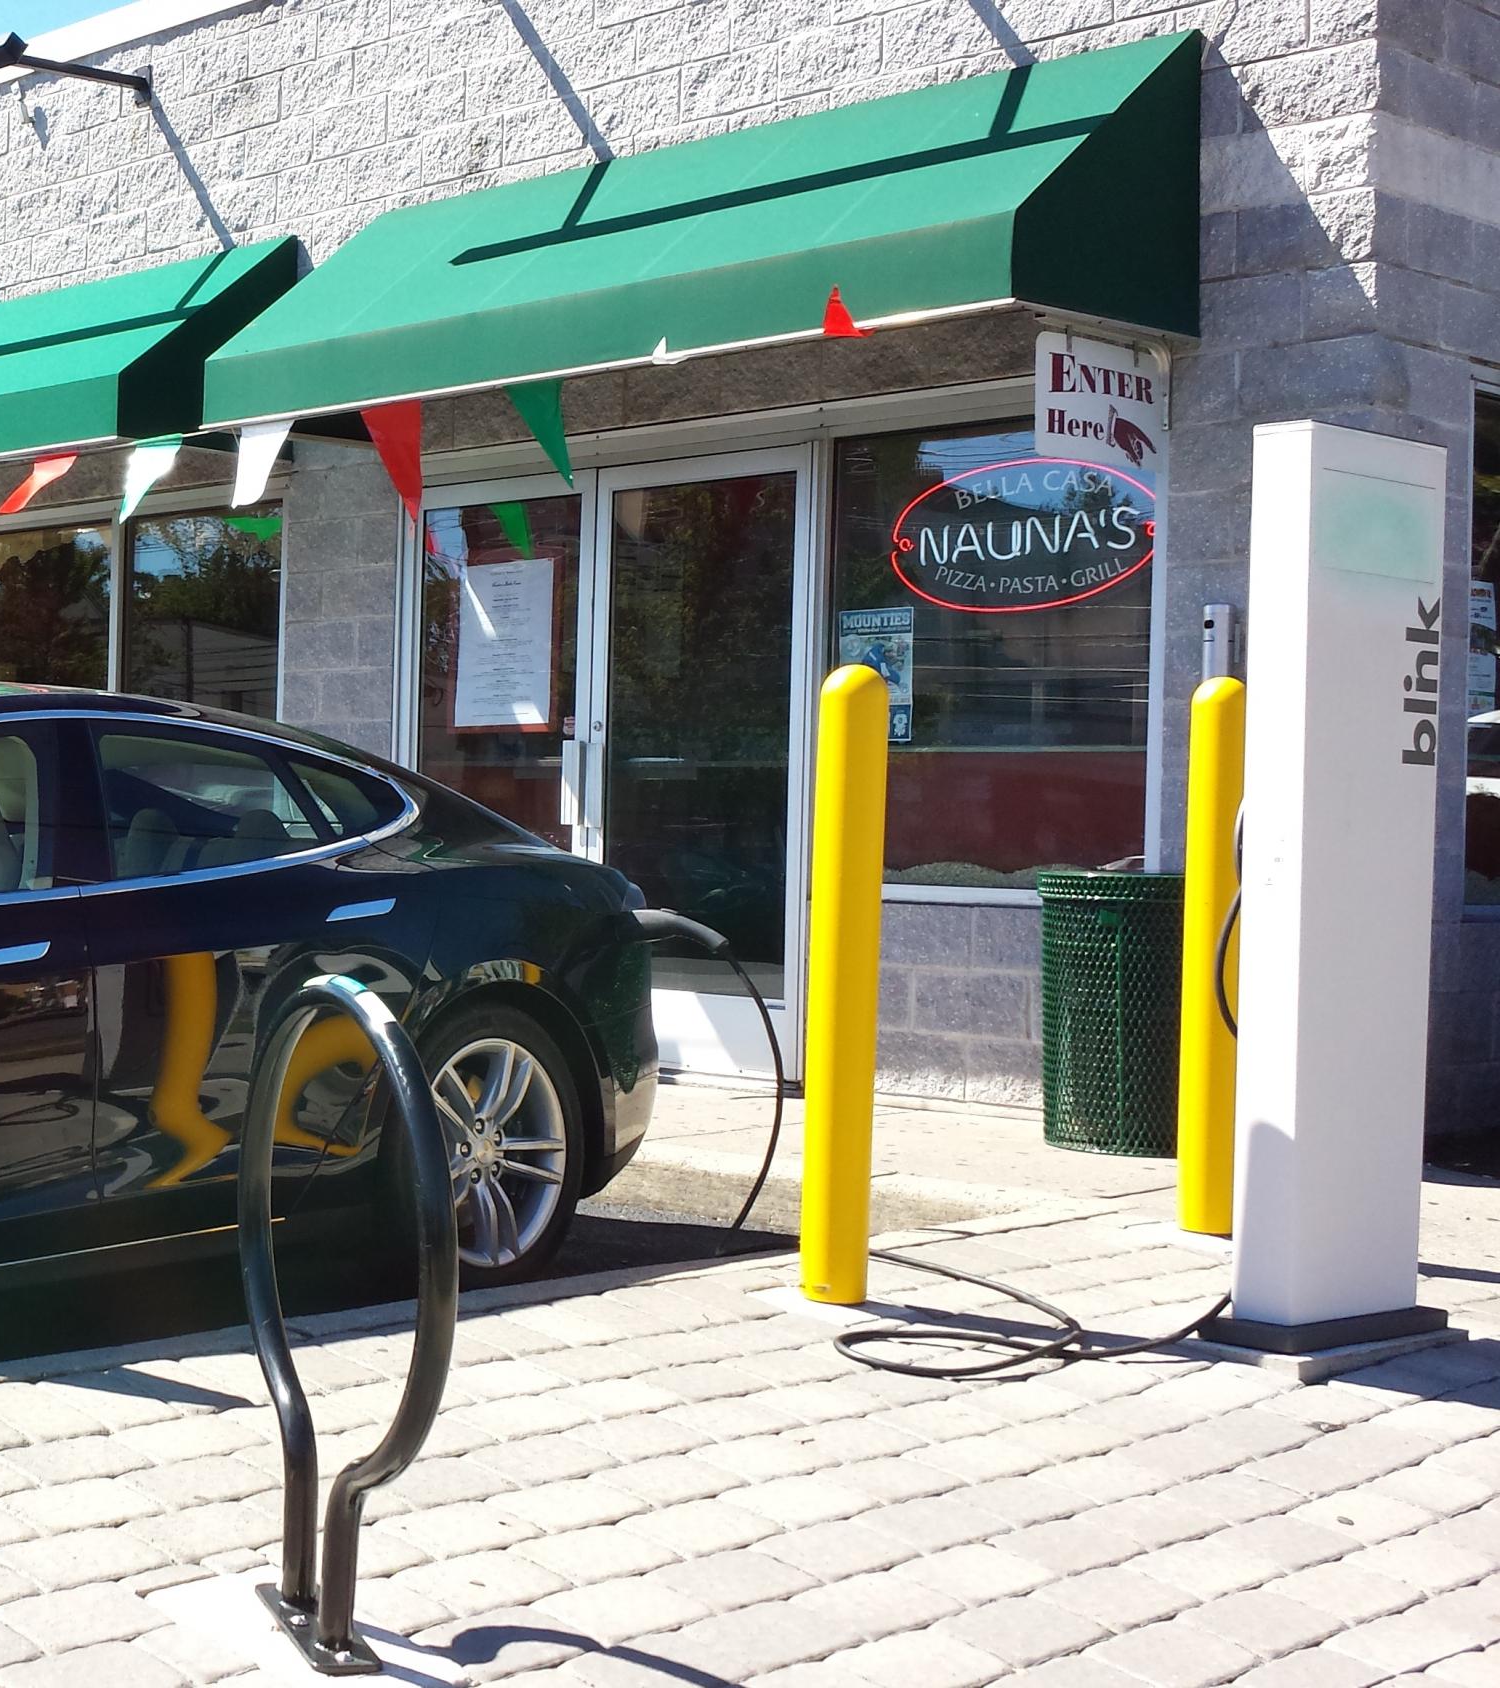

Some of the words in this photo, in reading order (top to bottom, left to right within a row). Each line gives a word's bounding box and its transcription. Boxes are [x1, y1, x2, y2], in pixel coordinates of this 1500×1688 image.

[1047, 408, 1105, 441] Here
[954, 472, 1034, 511] BELLA
[1042, 470, 1114, 496] CASA
[918, 506, 1140, 567] NAUNA'S
[842, 612, 911, 629] MOUNTIES
[1402, 596, 1441, 766] blink
